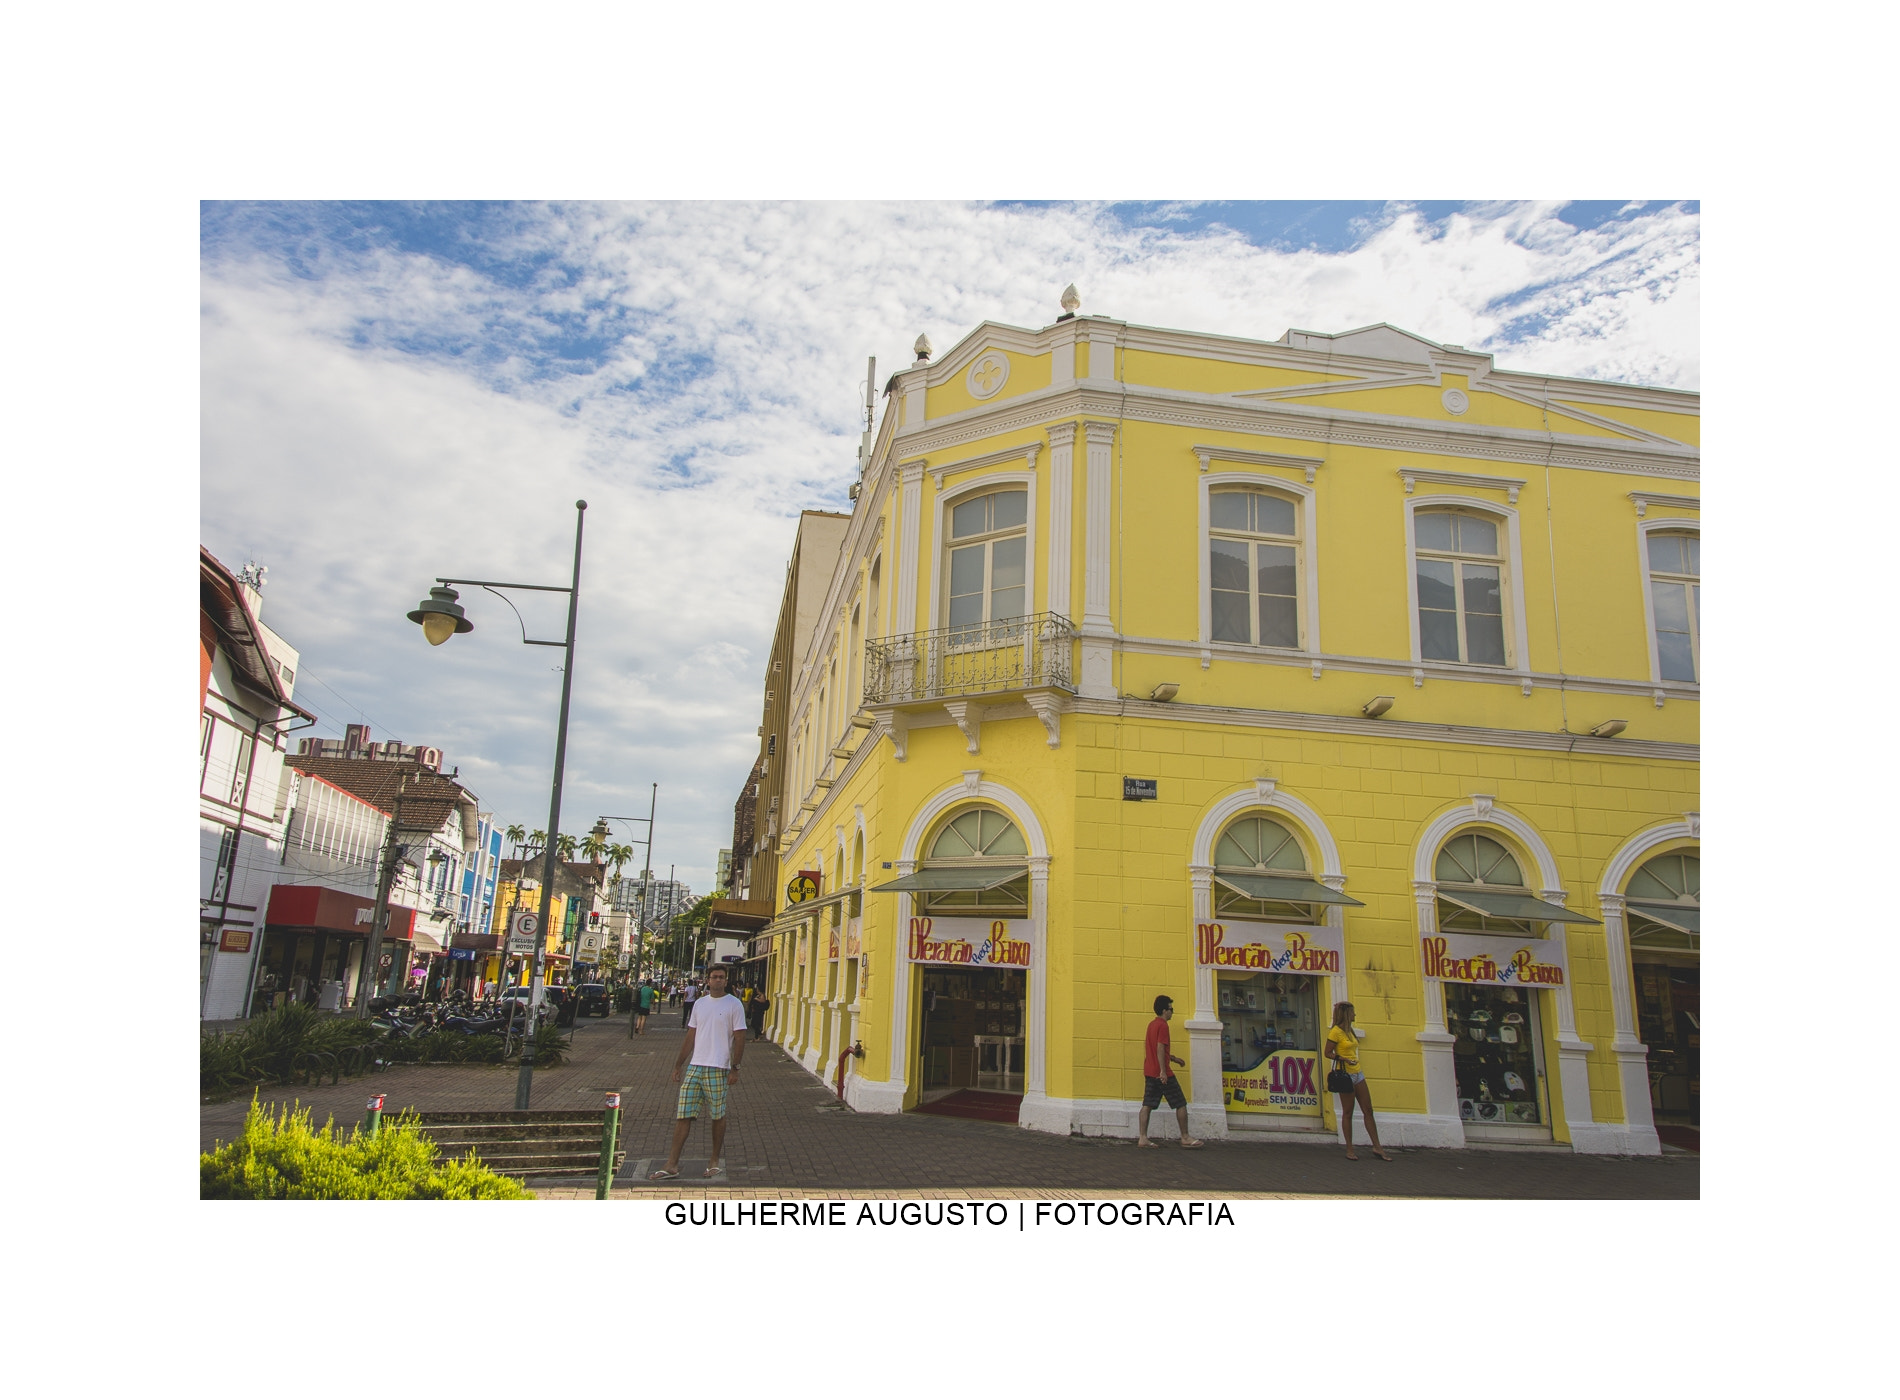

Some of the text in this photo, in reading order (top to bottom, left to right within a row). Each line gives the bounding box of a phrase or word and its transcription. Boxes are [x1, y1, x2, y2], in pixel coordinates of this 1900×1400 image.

[1125, 786, 1130, 795] 15
[1131, 786, 1136, 795] de
[523, 919, 532, 930] E
[587, 939, 594, 947] E
[1268, 1055, 1318, 1096] 10X
[1230, 1075, 1249, 1089] celular
[1249, 1078, 1258, 1089] em
[1259, 1074, 1268, 1090] até
[1269, 1095, 1318, 1106] SEM JUROS
